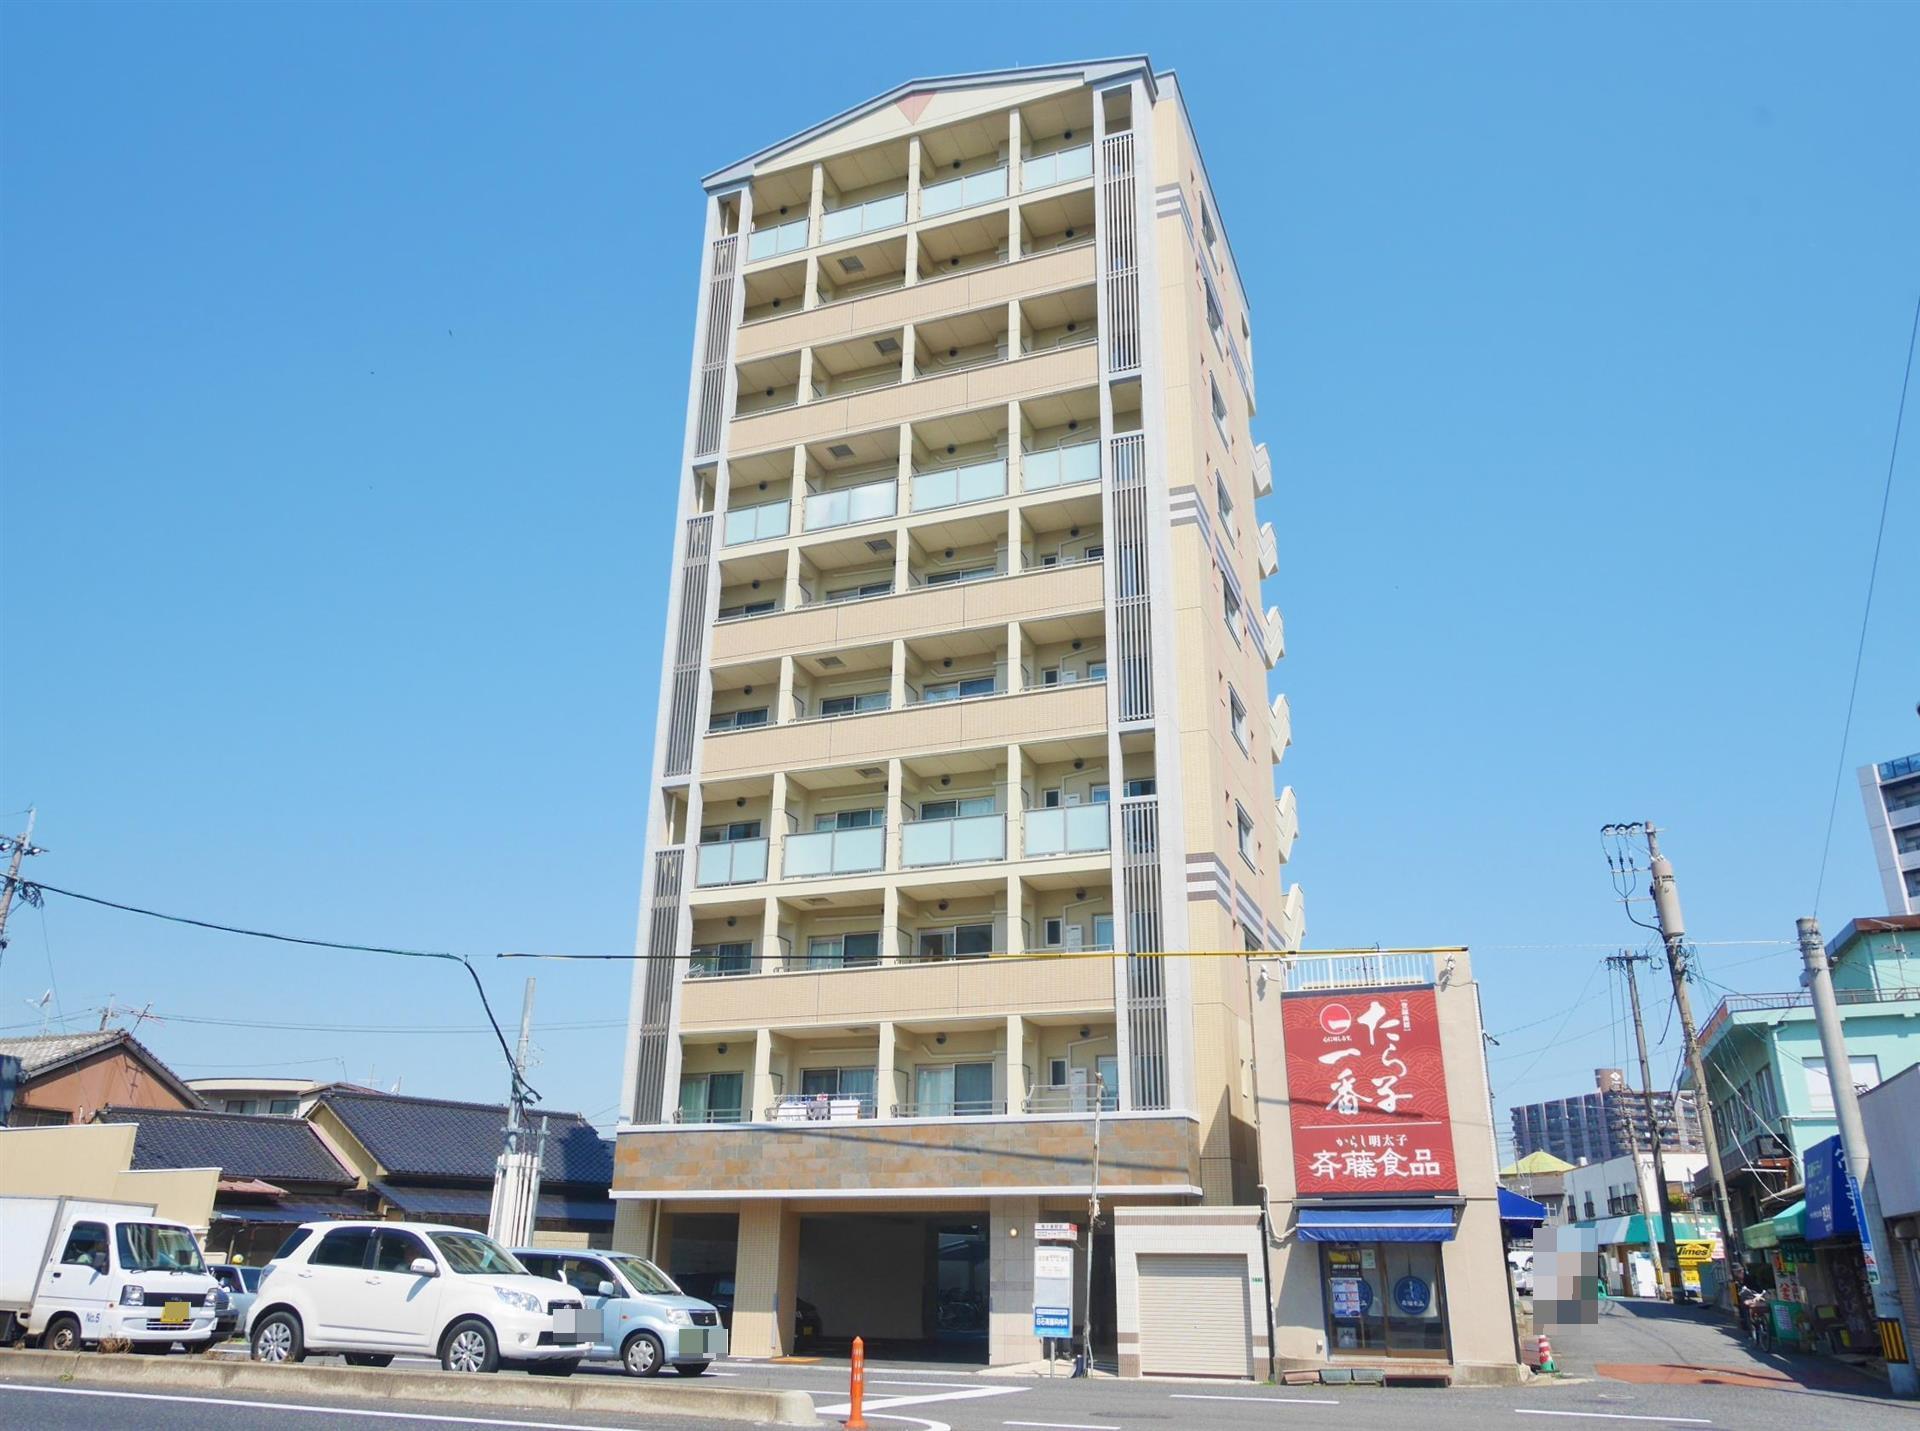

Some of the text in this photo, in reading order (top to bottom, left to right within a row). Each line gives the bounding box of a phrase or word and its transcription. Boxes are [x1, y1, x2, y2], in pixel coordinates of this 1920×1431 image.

[1357, 1001, 1414, 1113] たら子
[1318, 1048, 1373, 1115] 一番
[1335, 1134, 1408, 1148] からし明太子
[1308, 1147, 1440, 1180] 斉藤食品
[1676, 1244, 1708, 1256] Times
[86, 1312, 101, 1323] No.5
